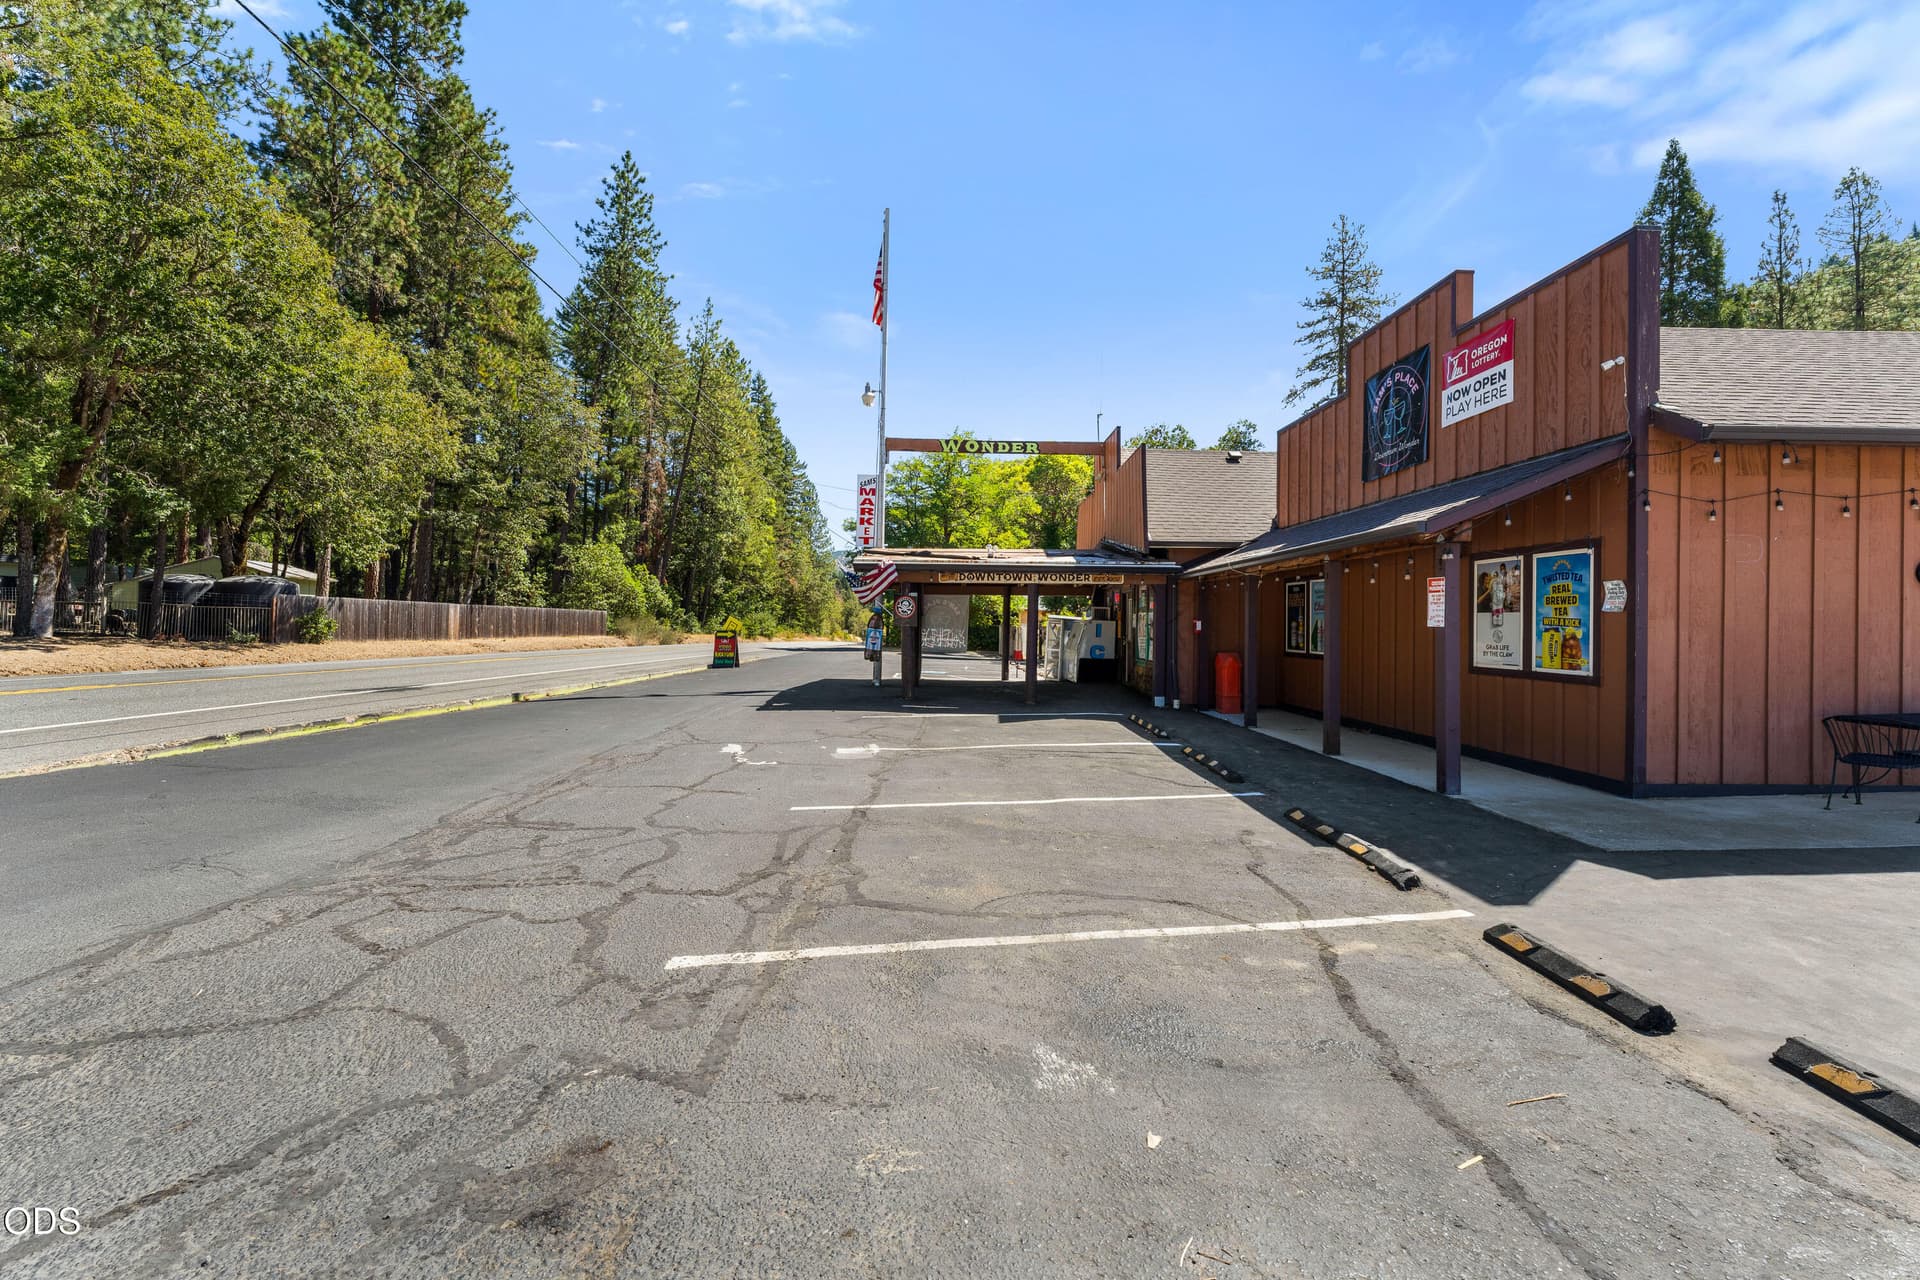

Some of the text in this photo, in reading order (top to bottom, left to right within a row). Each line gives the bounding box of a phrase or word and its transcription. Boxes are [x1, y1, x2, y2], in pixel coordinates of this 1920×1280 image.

[1471, 334, 1507, 359] OREGON
[1394, 372, 1420, 395] PLACE
[1447, 369, 1506, 405] NOW OPEN
[1446, 384, 1507, 420] PLAY HERE
[939, 439, 1039, 454] WONDER
[1398, 438, 1420, 451] Wonder
[858, 487, 876, 545] MARKET
[959, 572, 1033, 581] DOWNTOWN
[1038, 573, 1091, 582] WONDER
[1542, 571, 1583, 584] TWISTED TEA
[1551, 583, 1571, 595] REAL
[1545, 595, 1578, 605] BREWED
[1553, 606, 1568, 616] TEA
[1566, 619, 1580, 627] KICK
